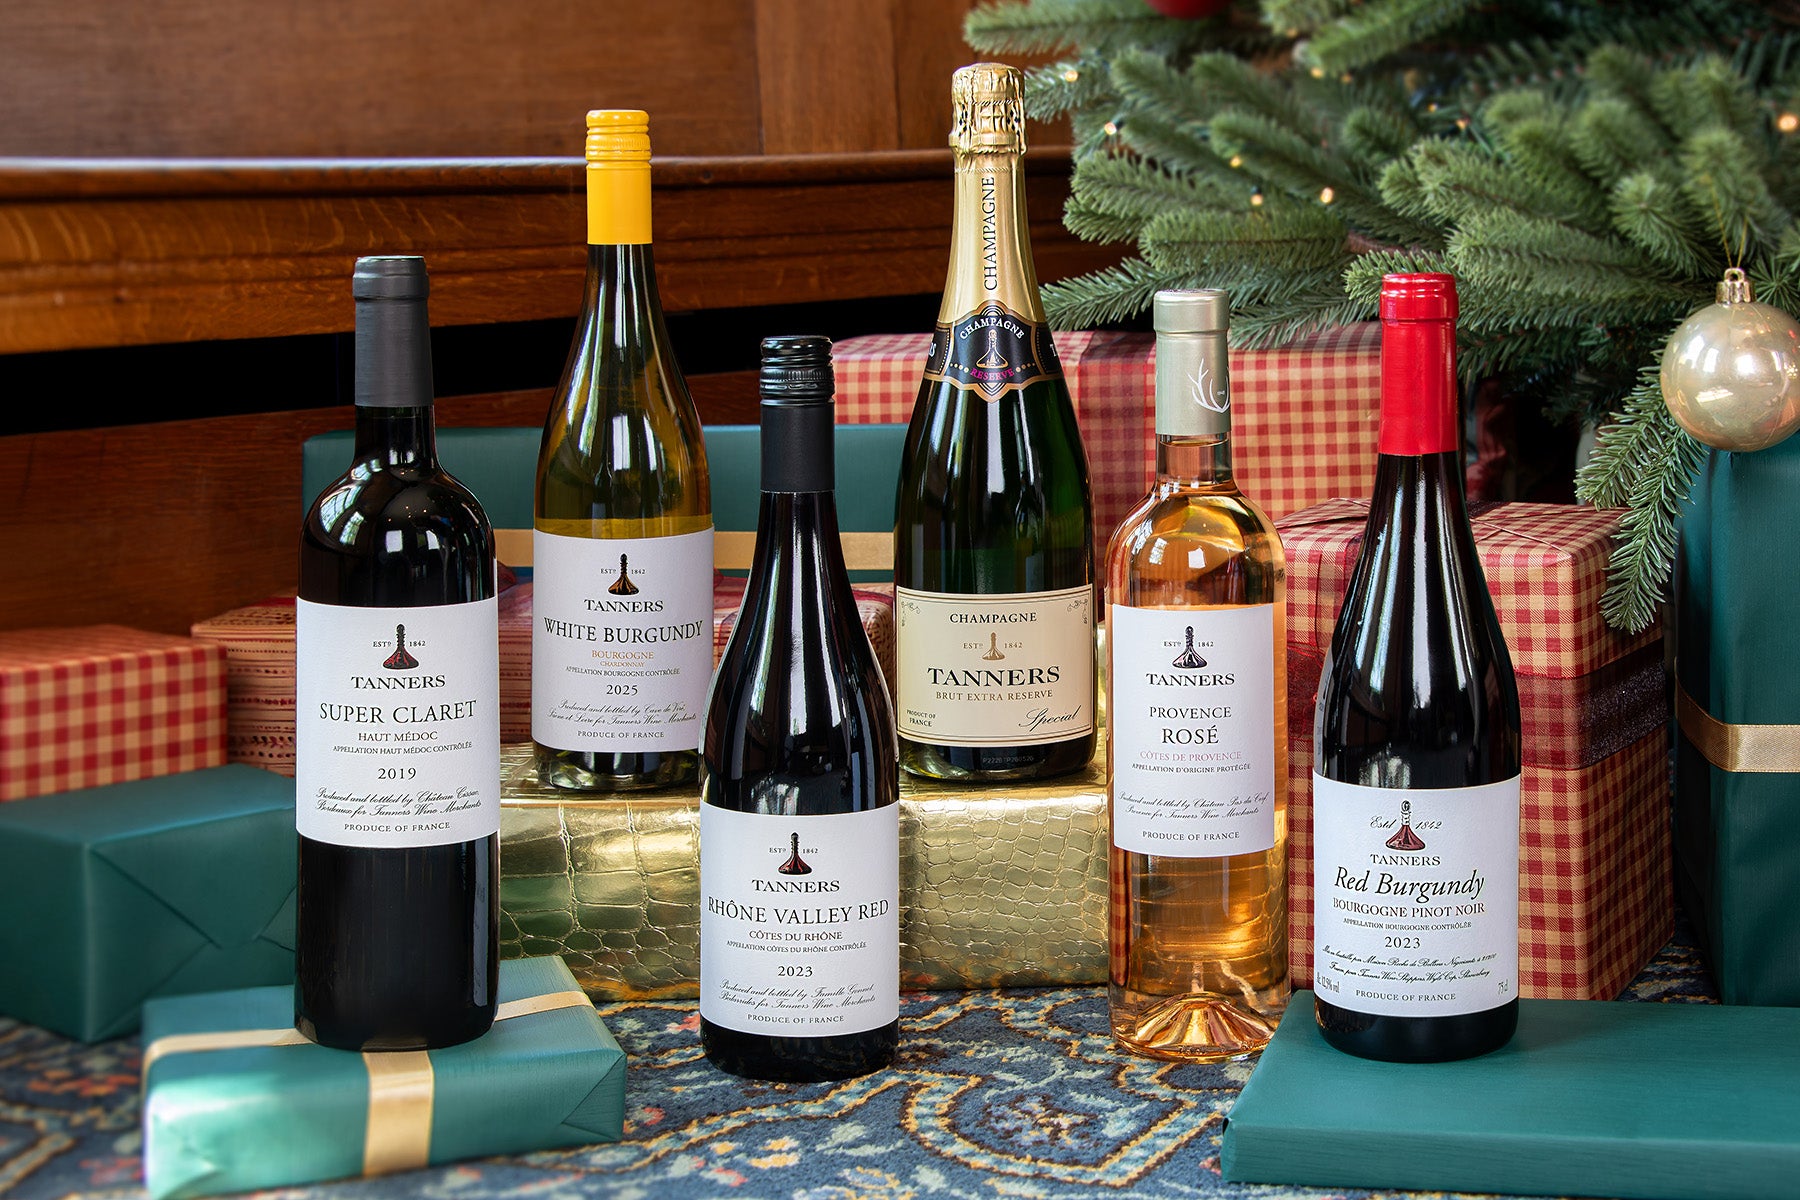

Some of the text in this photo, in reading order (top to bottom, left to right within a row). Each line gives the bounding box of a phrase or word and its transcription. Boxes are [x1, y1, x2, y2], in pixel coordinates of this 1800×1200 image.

[982, 177, 999, 291] CHAMPAGNE
[960, 317, 1025, 340] CHAMPAGNE
[970, 367, 1015, 381] RESERVE
[584, 599, 664, 612] TANNERS
[949, 612, 1037, 624] CHAMPAGNE
[544, 617, 703, 643] WHITE BURGUNDY
[591, 650, 654, 659] BOURGOGNE
[566, 666, 680, 677] APPELLATION BOURGOGNE CONTRÔLÉE
[927, 665, 1060, 687] TANNERS
[350, 674, 446, 689] TANNERS
[1146, 673, 1235, 687] TANNERS
[606, 684, 638, 695] 2025
[936, 690, 1053, 701] BRUT EXTRA RESERVE
[320, 700, 477, 723] SUPER CLARET
[558, 699, 590, 712] Produced
[589, 705, 605, 713] and
[605, 704, 630, 713] bottled
[630, 705, 641, 716] by
[663, 703, 673, 713] de
[1149, 706, 1232, 719] PROVENCE
[592, 715, 605, 727] for
[607, 715, 641, 725] Tanners
[641, 714, 662, 724] Wine
[664, 713, 697, 723] Merchants
[909, 717, 932, 727] FRANCE
[1018, 705, 1082, 732] Special
[358, 731, 438, 741] HAUT MÉDOC
[1162, 724, 1219, 745] ROSÉ
[333, 745, 378, 754] APPELLATION
[402, 745, 432, 754] MÉDOC
[433, 741, 472, 753] CONTRÔLÉE
[1140, 751, 1242, 762] CÔTES DE PROVENCE
[377, 768, 417, 780] 2019
[1132, 764, 1174, 773] APPELLATION
[1216, 763, 1251, 772] PROTÉGÉE
[315, 787, 352, 801] Produced
[350, 793, 370, 802] and
[369, 793, 402, 803] bottled
[401, 794, 413, 807] by
[416, 790, 454, 802] Château
[1118, 791, 1142, 803] Produced
[1154, 798, 1180, 807] bottled
[1180, 799, 1191, 810] by
[1192, 798, 1225, 808] Château
[315, 799, 482, 818] Bordeaux for Tanners Wine Merchants
[1151, 808, 1164, 820] for
[1165, 809, 1198, 819] Tanners
[1199, 808, 1220, 820] Wine
[1221, 807, 1259, 818] Merchants
[344, 822, 450, 832] PRODUCE OF FRANCE
[1415, 821, 1443, 830] 1842
[1142, 831, 1240, 841] PRODUCE OF FRANCE
[1370, 854, 1441, 866] TANNERS
[752, 879, 840, 893] TANNERS
[1334, 866, 1485, 904] Red Burgundy
[708, 896, 889, 924] RHÔNE VALLEY RED
[1333, 897, 1485, 918] BOURGOGNE PINOT NOIR
[1343, 917, 1472, 931] APPELLATION BOURGOGNE CONTRÔLÉE
[749, 930, 843, 941] CÔTES DU RHÔNE
[726, 941, 766, 952] APPELLATION
[766, 944, 789, 953] CÔTES
[802, 945, 828, 953] RHÔNE
[828, 941, 867, 952] CONTRÔLÉE
[1384, 937, 1421, 948] 2023
[777, 966, 813, 977] 2023
[1357, 968, 1380, 979] Tanners
[1381, 971, 1398, 980] Wine
[719, 979, 753, 993] Produced
[751, 986, 769, 995] and
[768, 988, 798, 997] bottled
[797, 989, 808, 1000] by
[811, 987, 847, 998] Famille
[1356, 990, 1399, 1001] PRODUCE
[755, 999, 768, 1010] for
[771, 998, 809, 1009] Tanners
[811, 998, 833, 1010] Wine
[836, 995, 876, 1008] Merchants
[748, 1014, 790, 1023] PRODUCE
[809, 1015, 844, 1023] FRANCE
